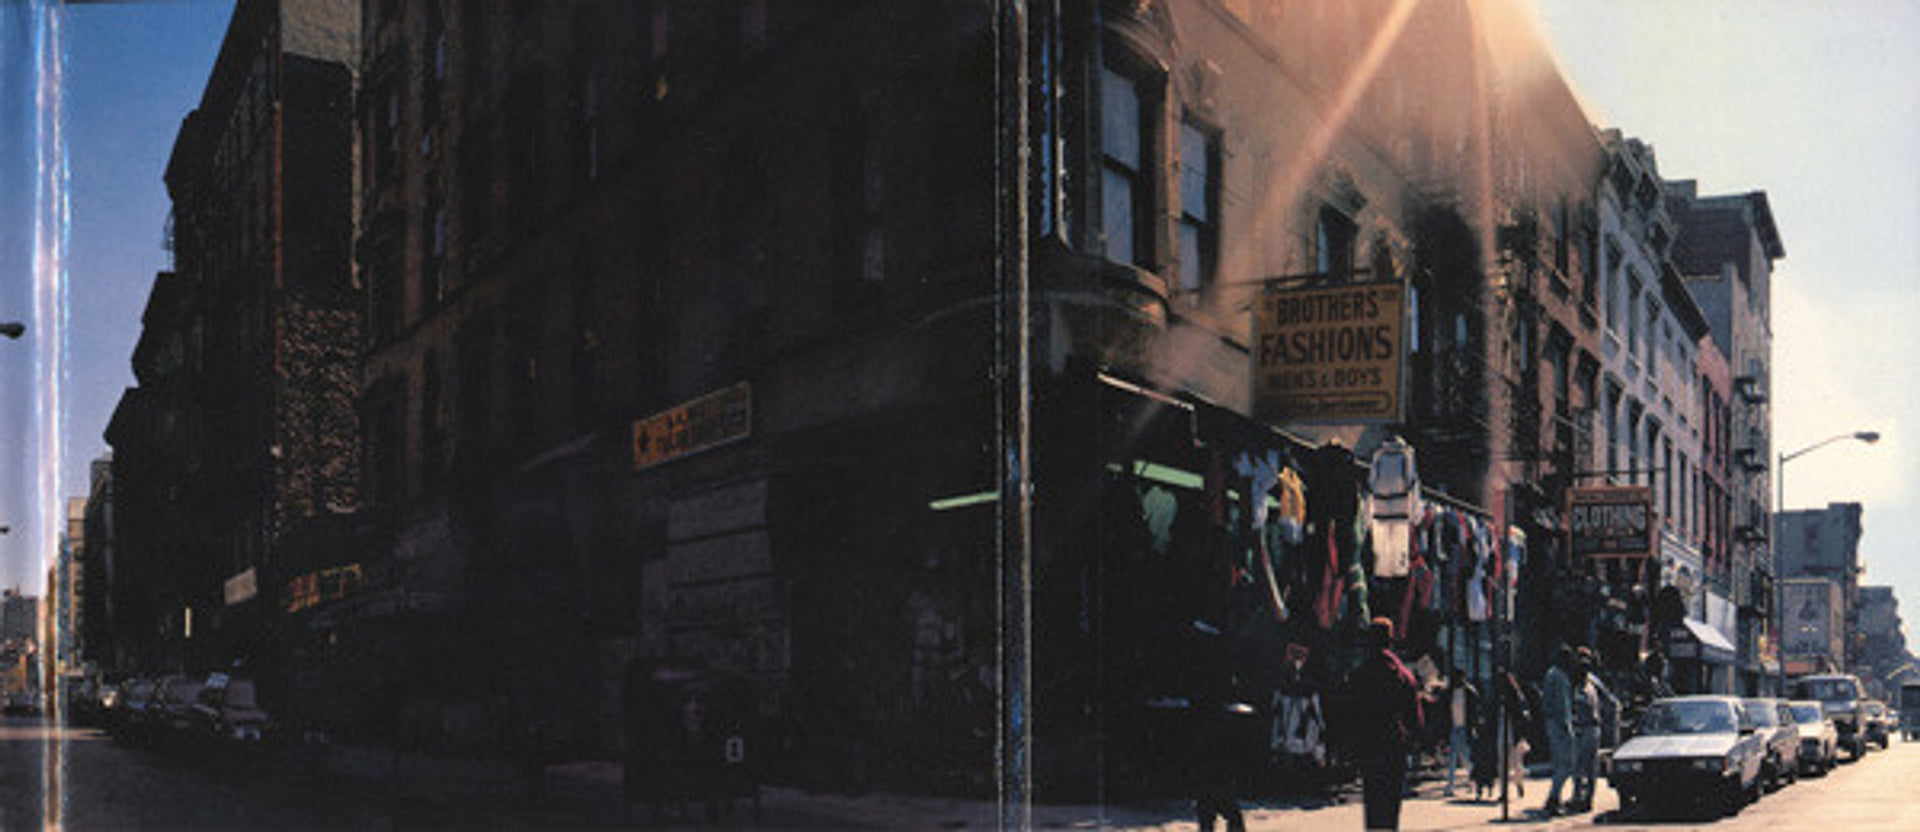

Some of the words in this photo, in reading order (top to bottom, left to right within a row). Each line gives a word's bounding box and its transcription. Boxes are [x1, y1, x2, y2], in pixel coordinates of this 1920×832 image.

[1276, 290, 1380, 327] BROTHERS
[1260, 324, 1393, 367] FASHIONS
[1572, 504, 1647, 533] CLOTHING
